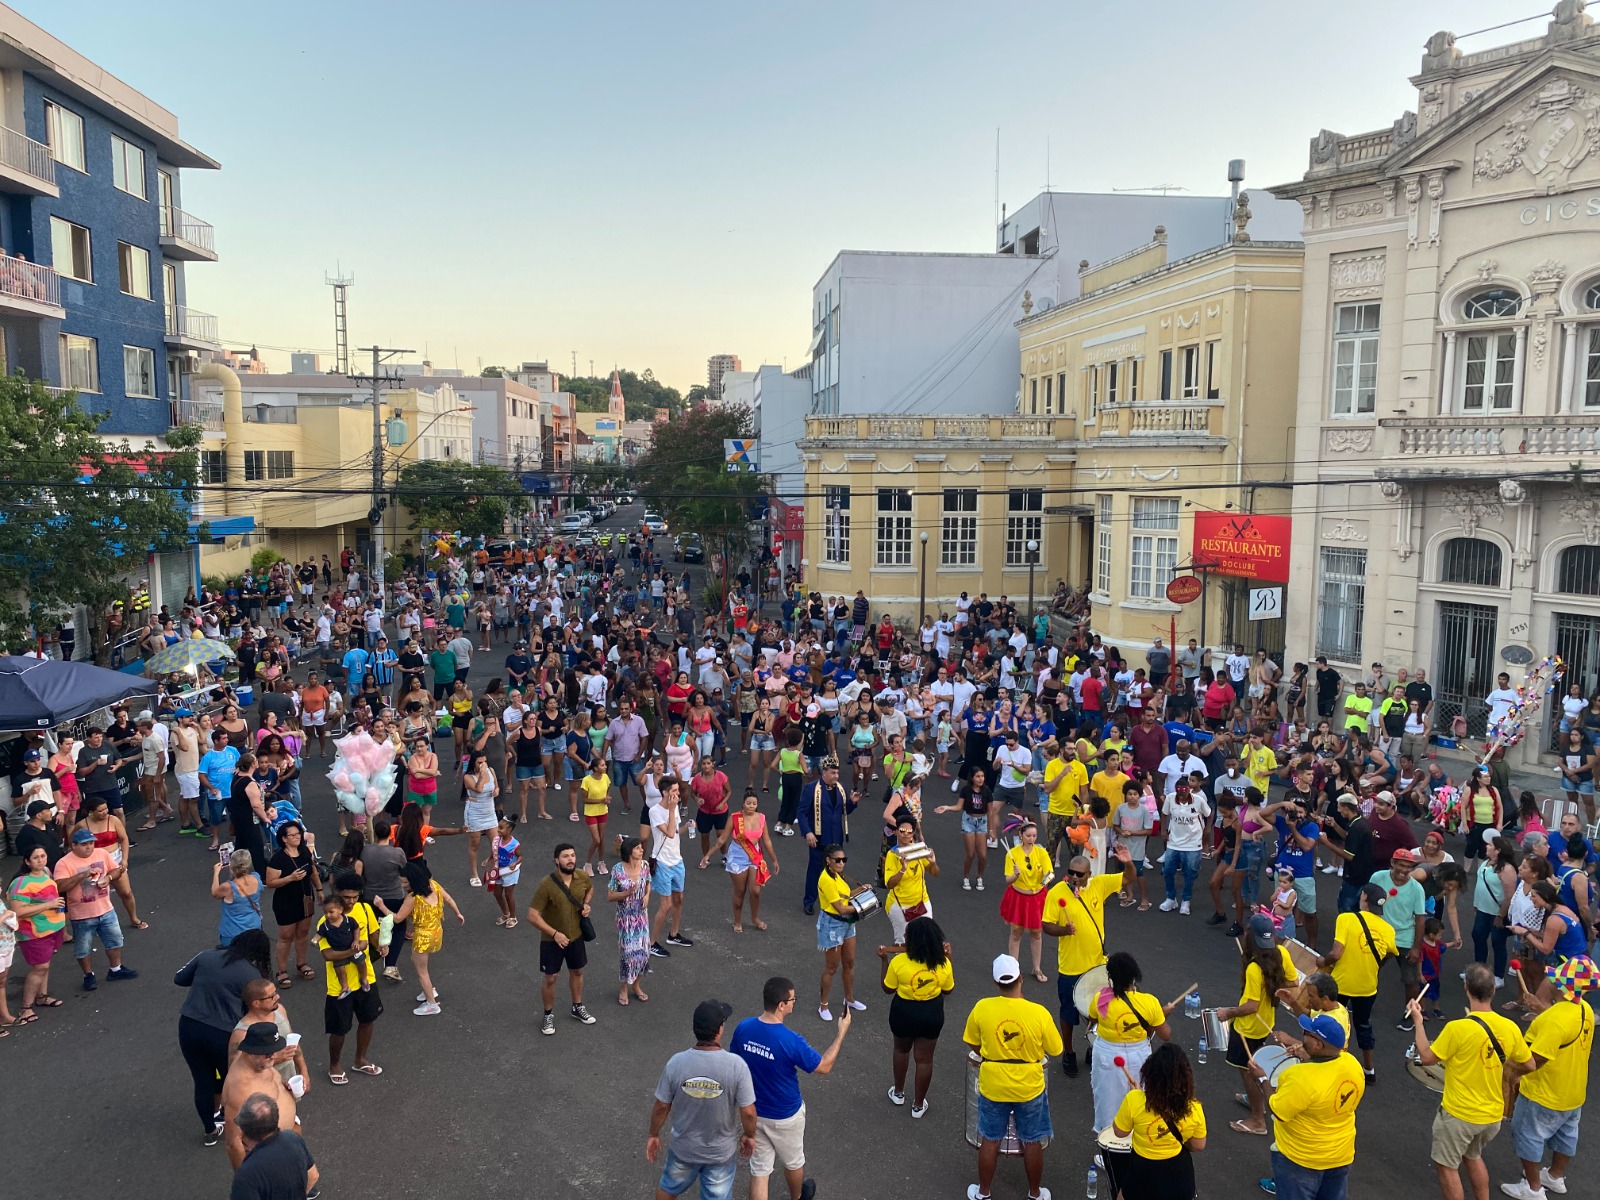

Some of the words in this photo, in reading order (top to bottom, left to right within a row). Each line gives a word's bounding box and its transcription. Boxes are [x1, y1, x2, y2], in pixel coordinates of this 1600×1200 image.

[727, 463, 756, 472] CAIA
[1201, 538, 1281, 557] RESTAURANTE
[1510, 622, 1528, 635] 2751
[355, 661, 362, 674] 9
[743, 1043, 775, 1060] TAQUARA
